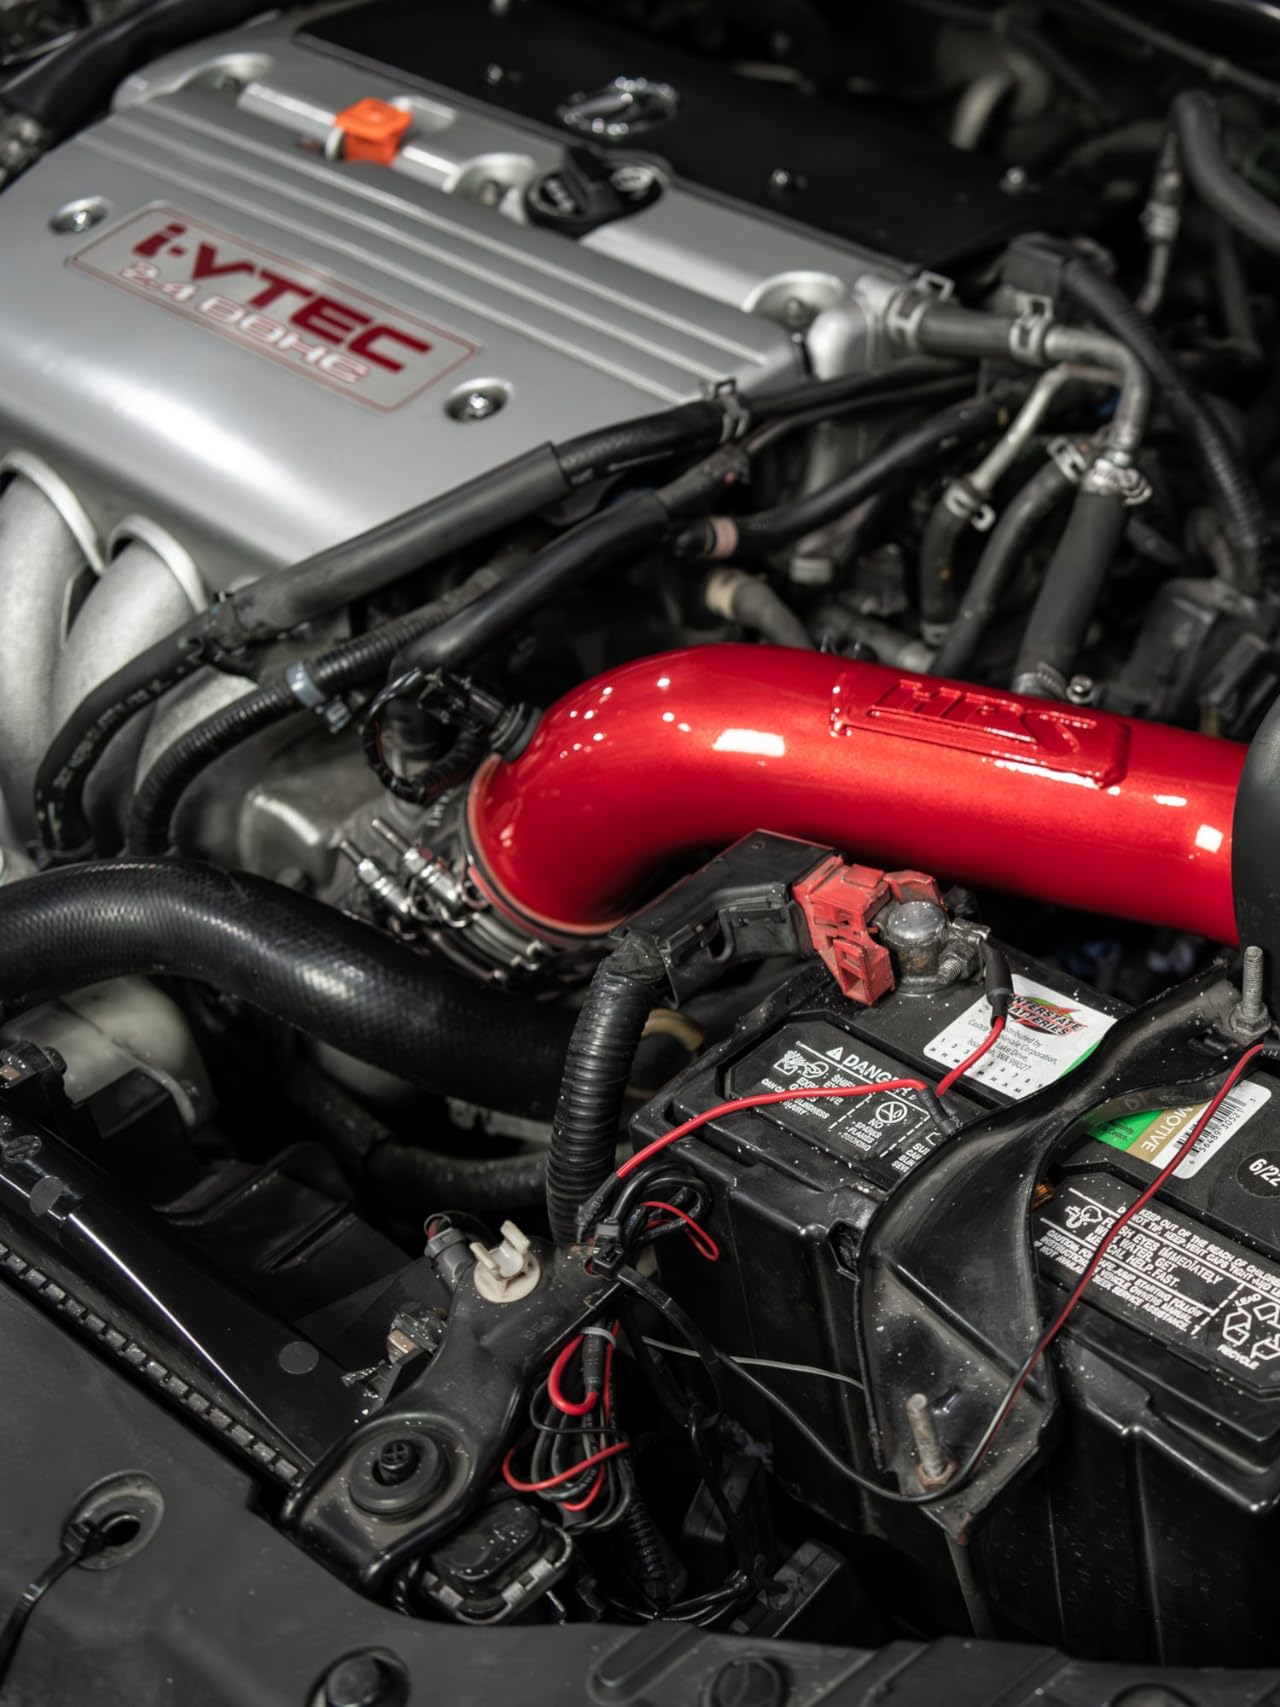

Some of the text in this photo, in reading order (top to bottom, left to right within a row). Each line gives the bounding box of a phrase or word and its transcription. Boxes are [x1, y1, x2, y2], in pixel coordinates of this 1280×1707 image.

[132, 222, 433, 375] i-VTEC
[848, 1127, 875, 1144] FLAMES
[854, 1122, 883, 1139] SPARKS
[868, 1118, 885, 1129] NO
[1140, 1105, 1194, 1153] MOTIVE
[1084, 1233, 1129, 1259] MECAL
[1101, 1218, 1225, 1285] FLSH EYES IMMEDIATELY
[1139, 1209, 1162, 1223] KEEP
[1159, 1219, 1180, 1232] OUT
[1176, 1228, 1193, 1239] OF
[1189, 1235, 1210, 1248] THE
[1206, 1244, 1236, 1262] REACH
[1233, 1258, 1249, 1268] OF
[1040, 1243, 1058, 1259] NOT
[1112, 1286, 1145, 1306] SERVICE
[1098, 1270, 1131, 1289] VEHICLE
[1153, 1258, 1178, 1273] GET
[1205, 1253, 1231, 1268] CAPS
[1227, 1265, 1254, 1281] TIGHT
[1134, 1279, 1174, 1301] STARTING
[1170, 1298, 1204, 1318] FOLLOW
